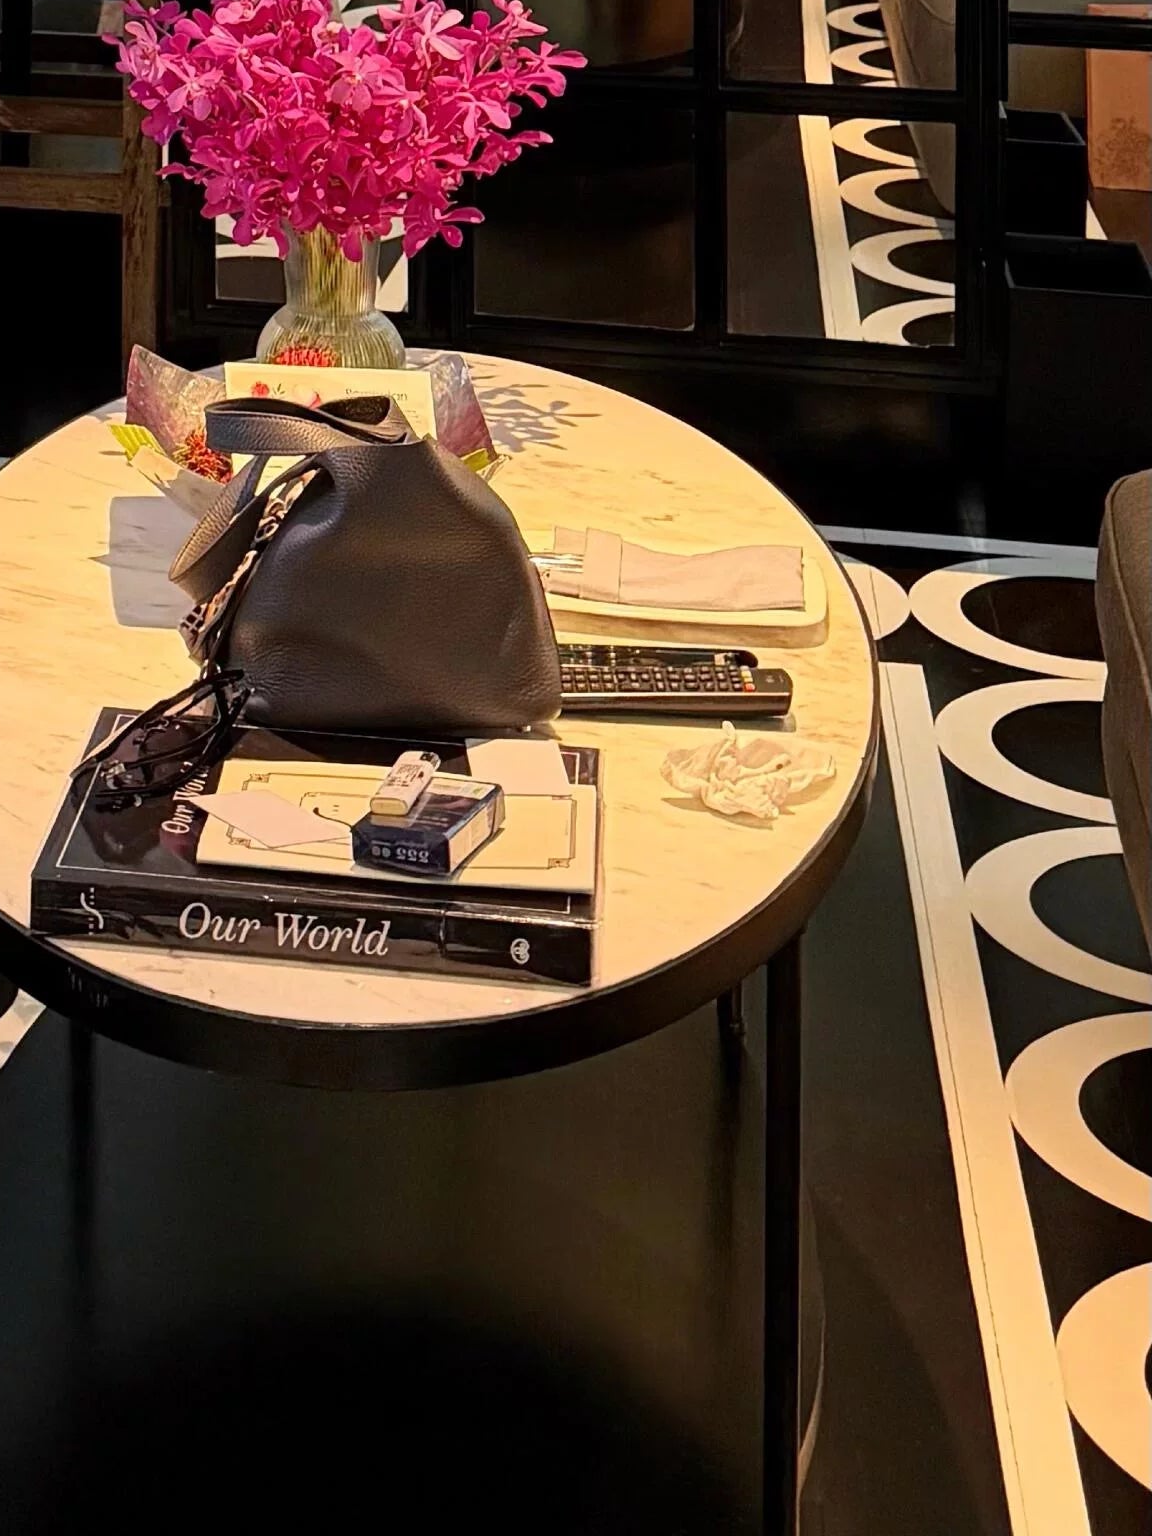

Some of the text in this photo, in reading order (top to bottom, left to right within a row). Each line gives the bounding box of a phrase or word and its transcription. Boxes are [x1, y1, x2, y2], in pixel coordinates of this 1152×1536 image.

[161, 804, 194, 834] Our
[179, 902, 391, 956] Our World
